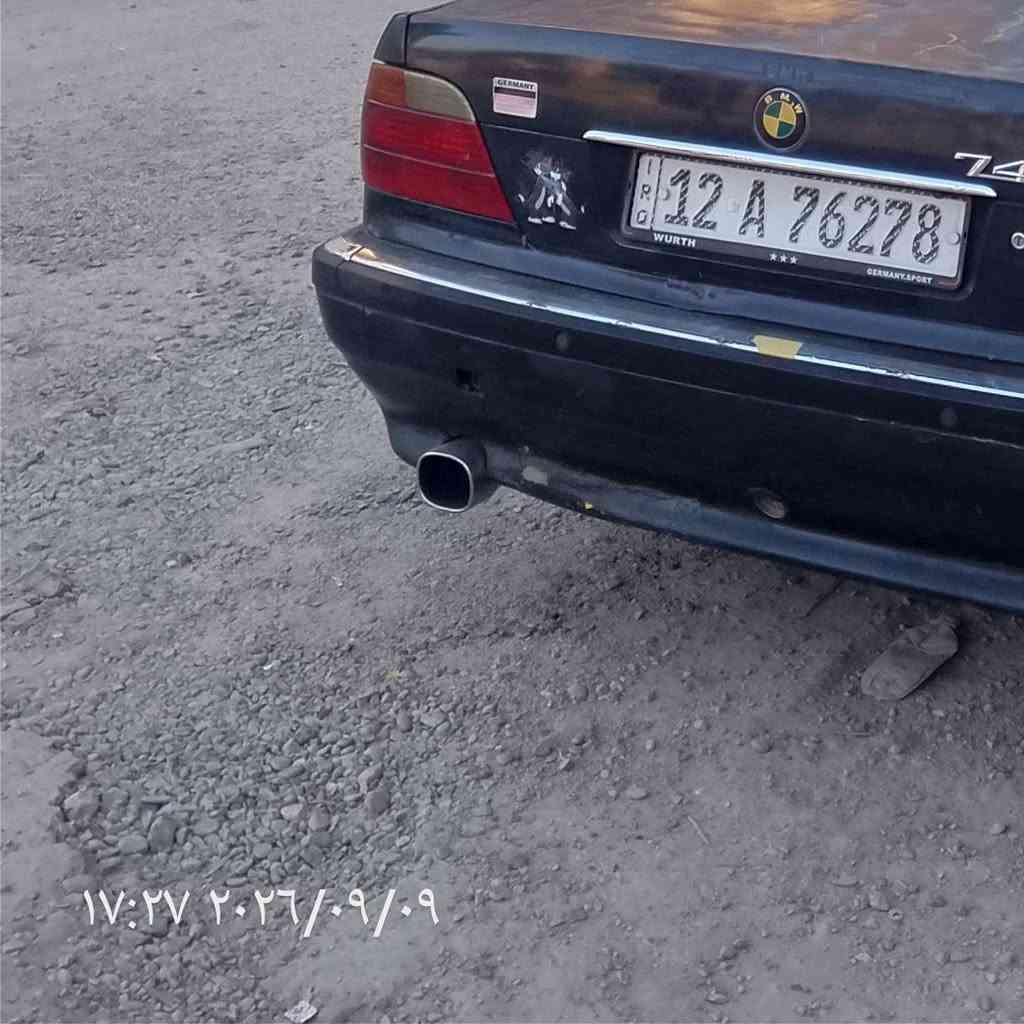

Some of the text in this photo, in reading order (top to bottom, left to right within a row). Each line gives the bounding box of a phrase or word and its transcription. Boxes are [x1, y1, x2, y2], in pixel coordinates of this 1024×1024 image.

[764, 91, 804, 114] BMW
[664, 168, 942, 265] 12 A 76278
[652, 232, 697, 249] WURTH
